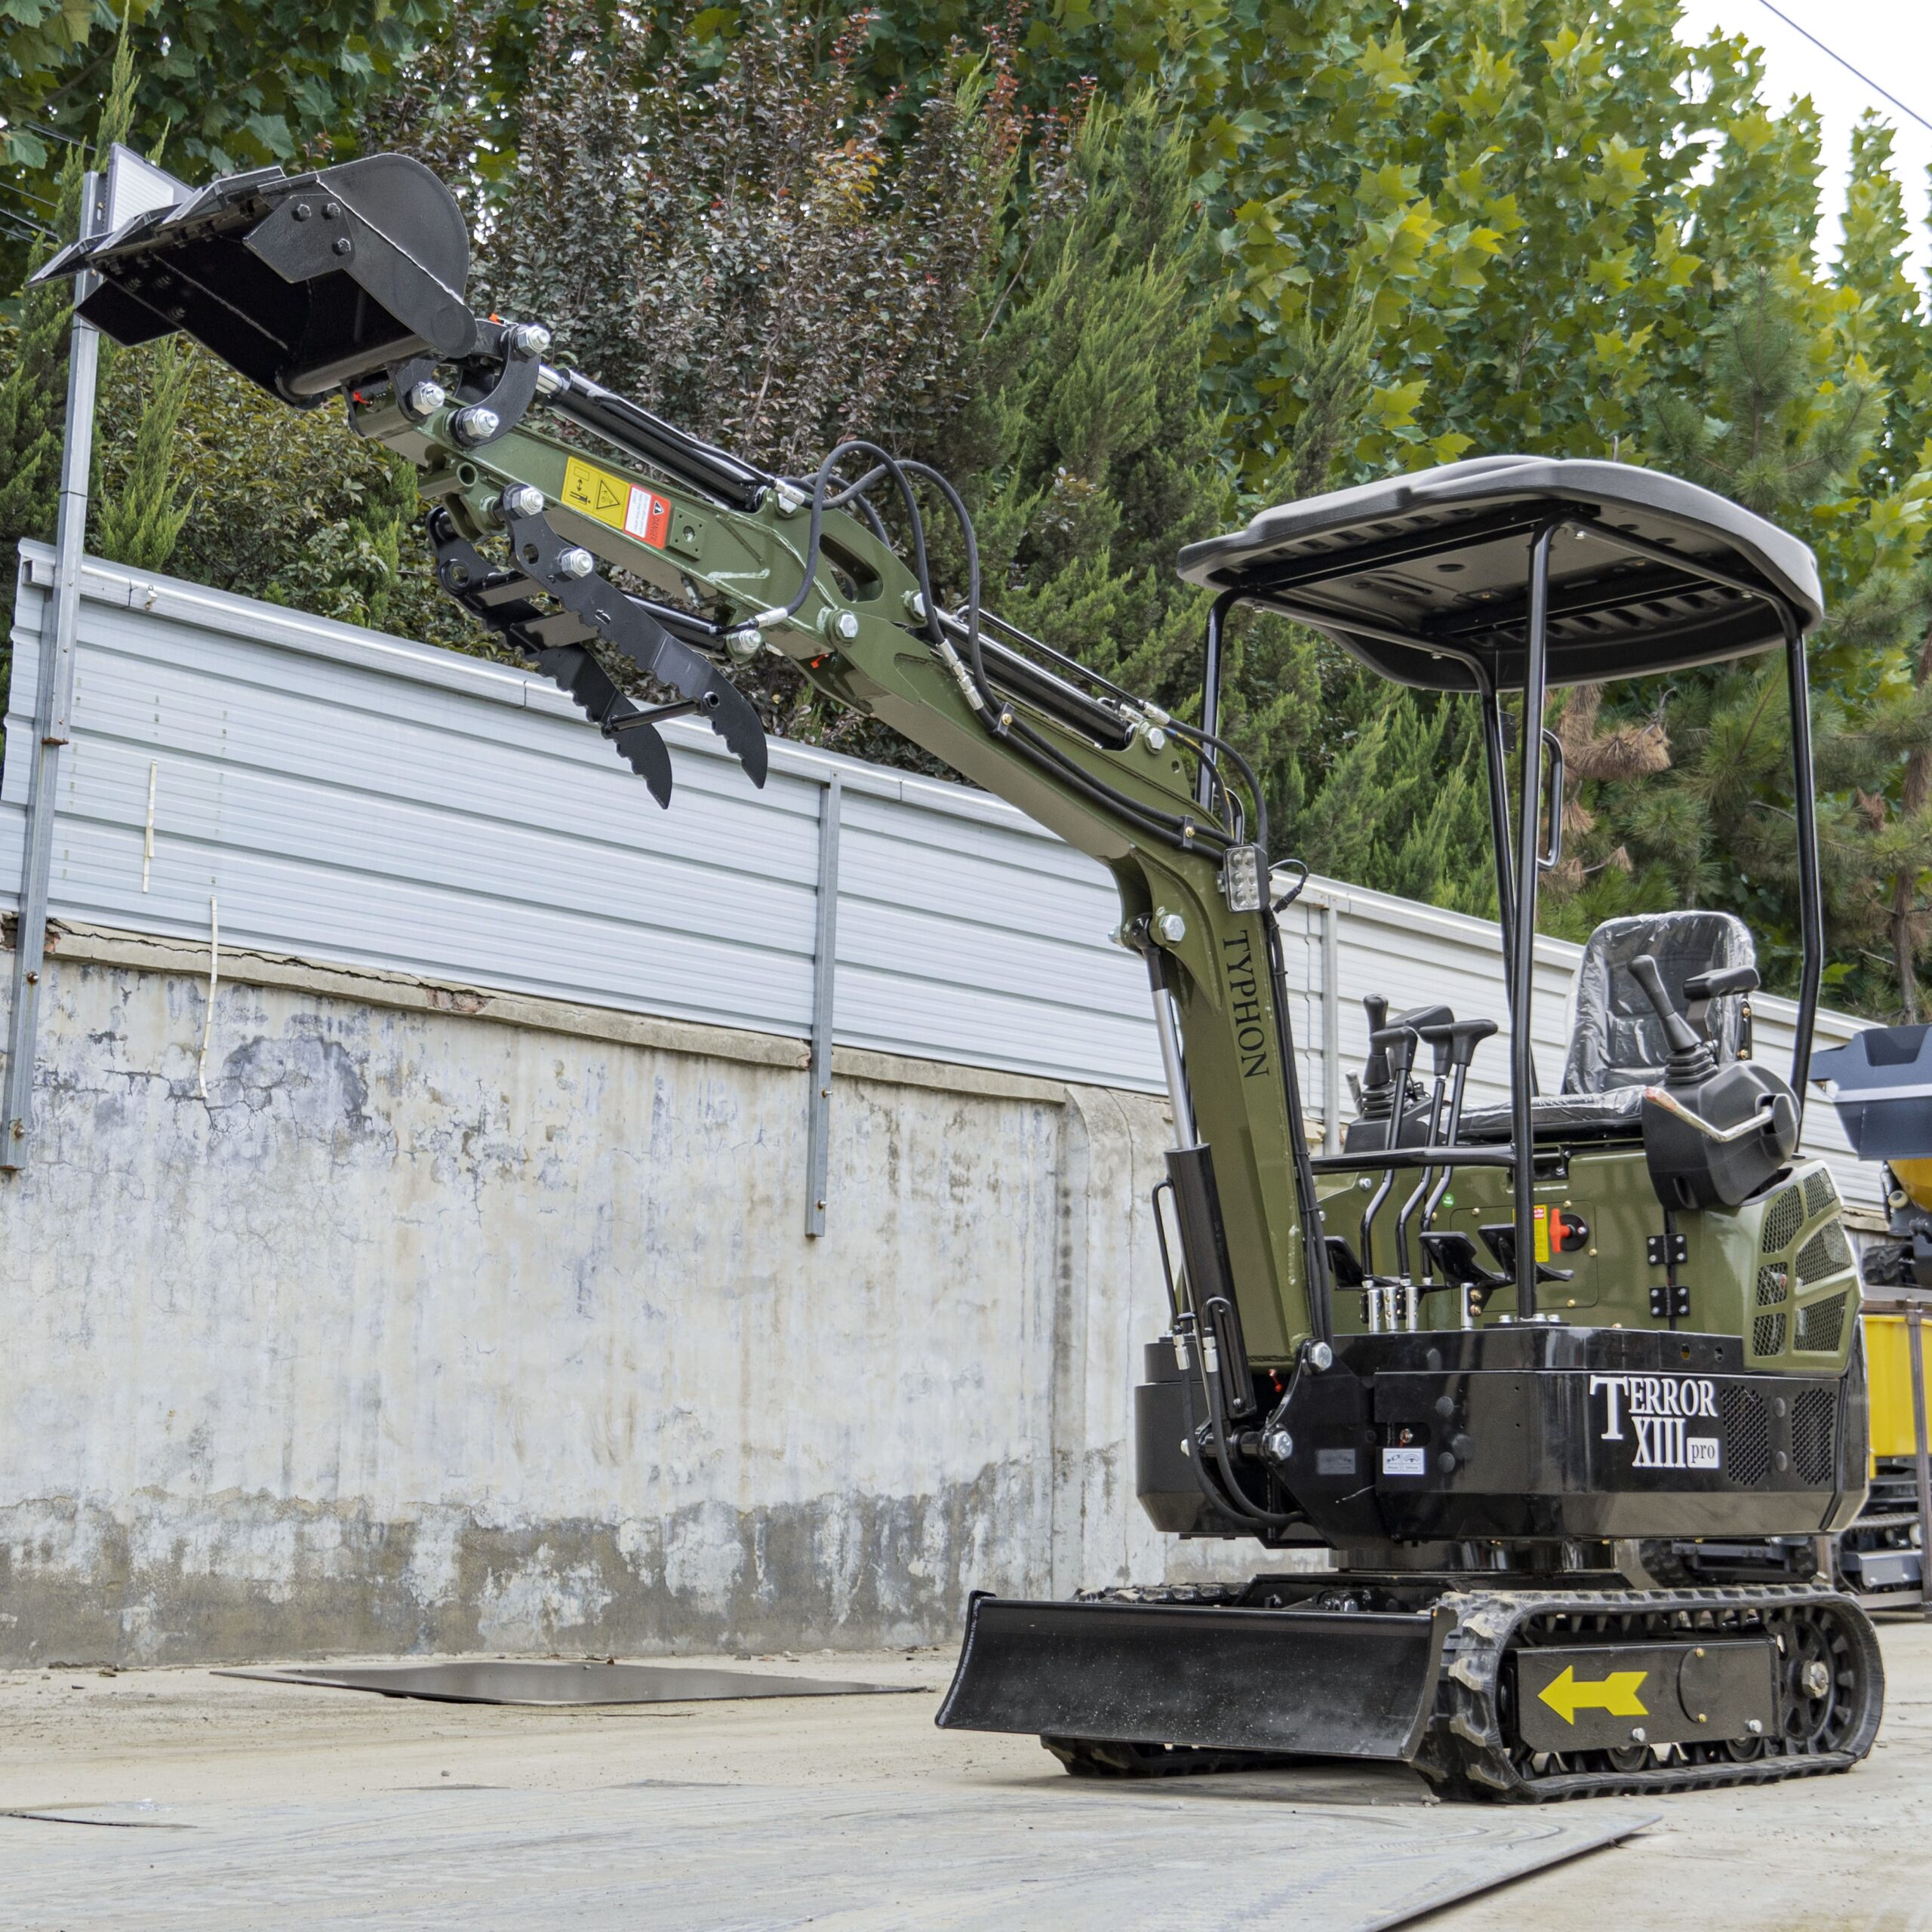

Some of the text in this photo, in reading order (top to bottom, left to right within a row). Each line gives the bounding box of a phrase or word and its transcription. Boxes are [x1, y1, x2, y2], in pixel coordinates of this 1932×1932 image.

[650, 516, 660, 541] DANGER
[1223, 930, 1269, 1078] TYPHON
[1589, 1375, 1718, 1440] TERROR
[1632, 1416, 1715, 1467] XIII pro
